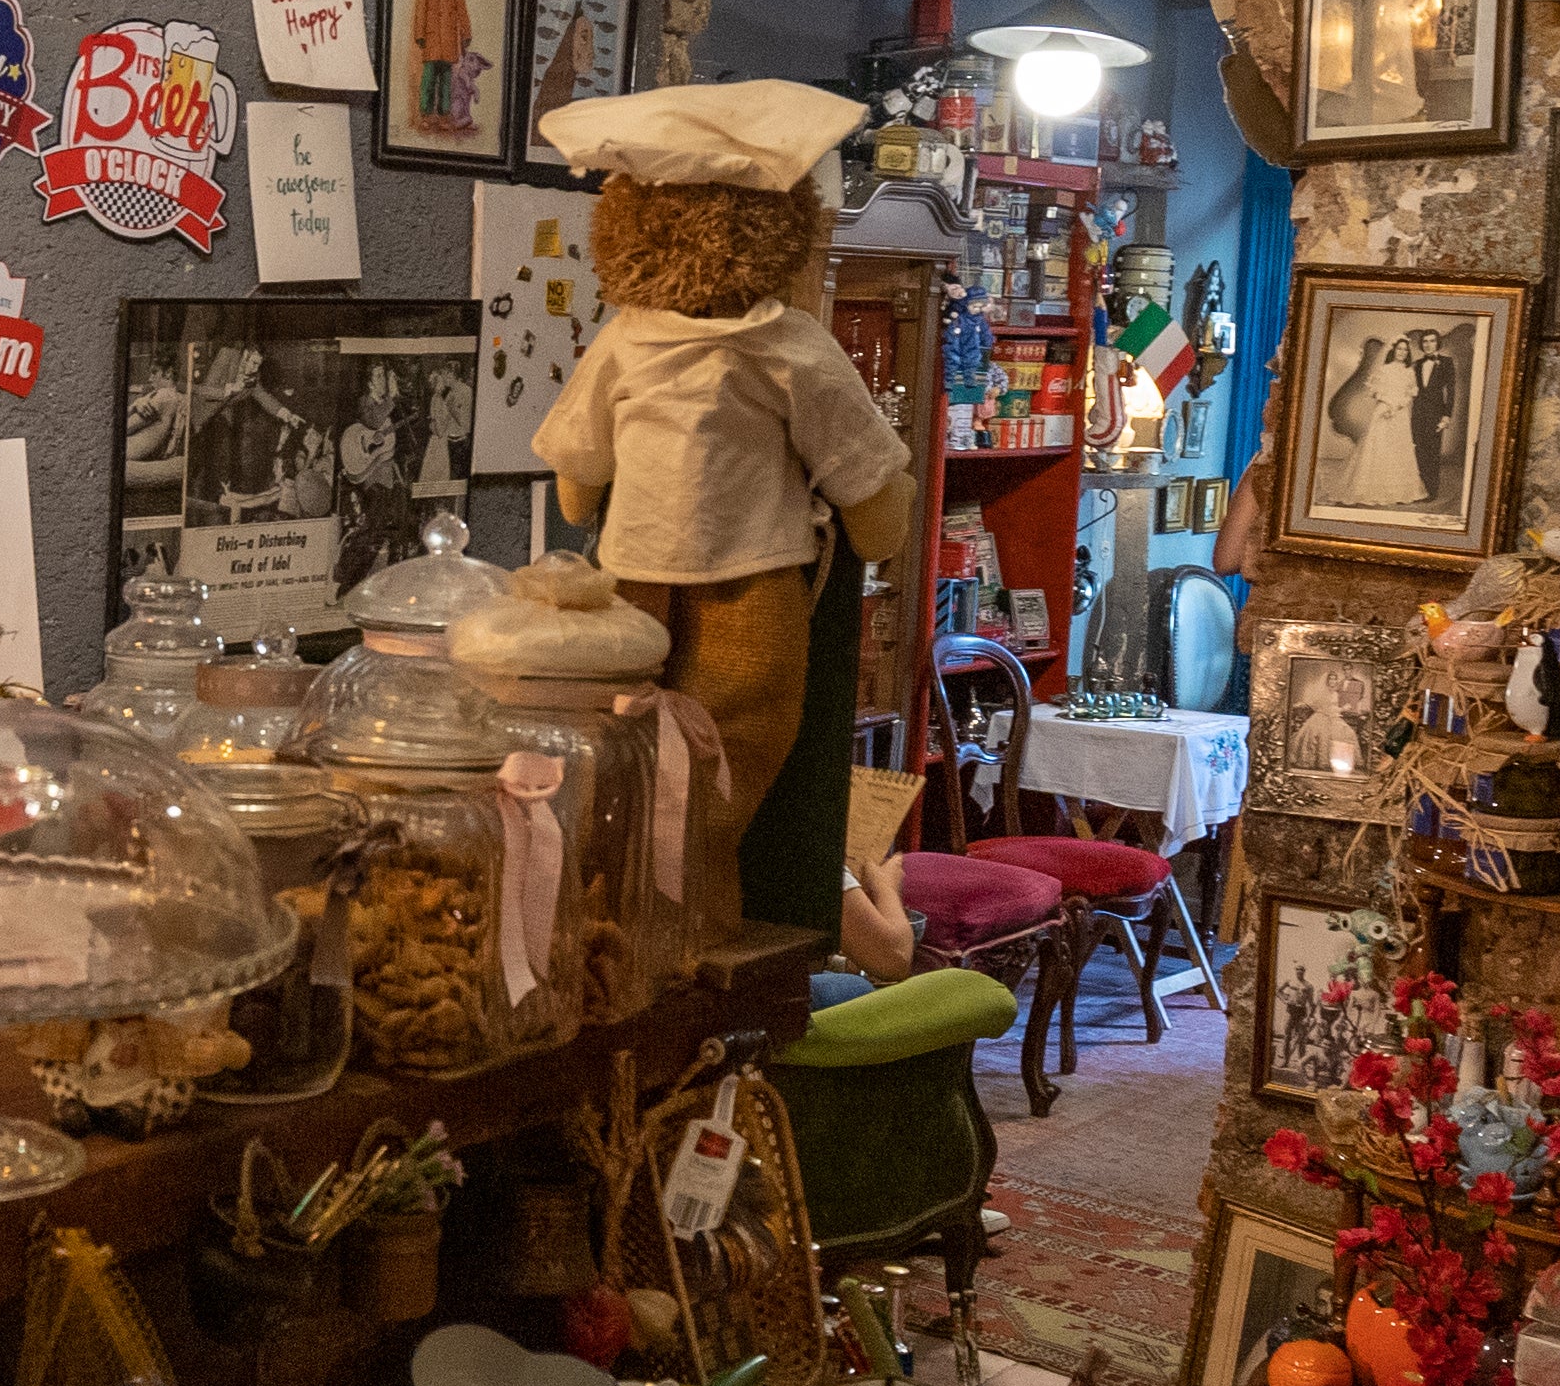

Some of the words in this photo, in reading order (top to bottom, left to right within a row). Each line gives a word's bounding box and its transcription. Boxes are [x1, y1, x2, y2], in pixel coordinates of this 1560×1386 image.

[285, 4, 344, 46] Happy
[73, 33, 215, 152] Beer
[85, 148, 187, 199] O'CLOCK
[230, 557, 254, 574] Kind
[257, 555, 269, 572] of
